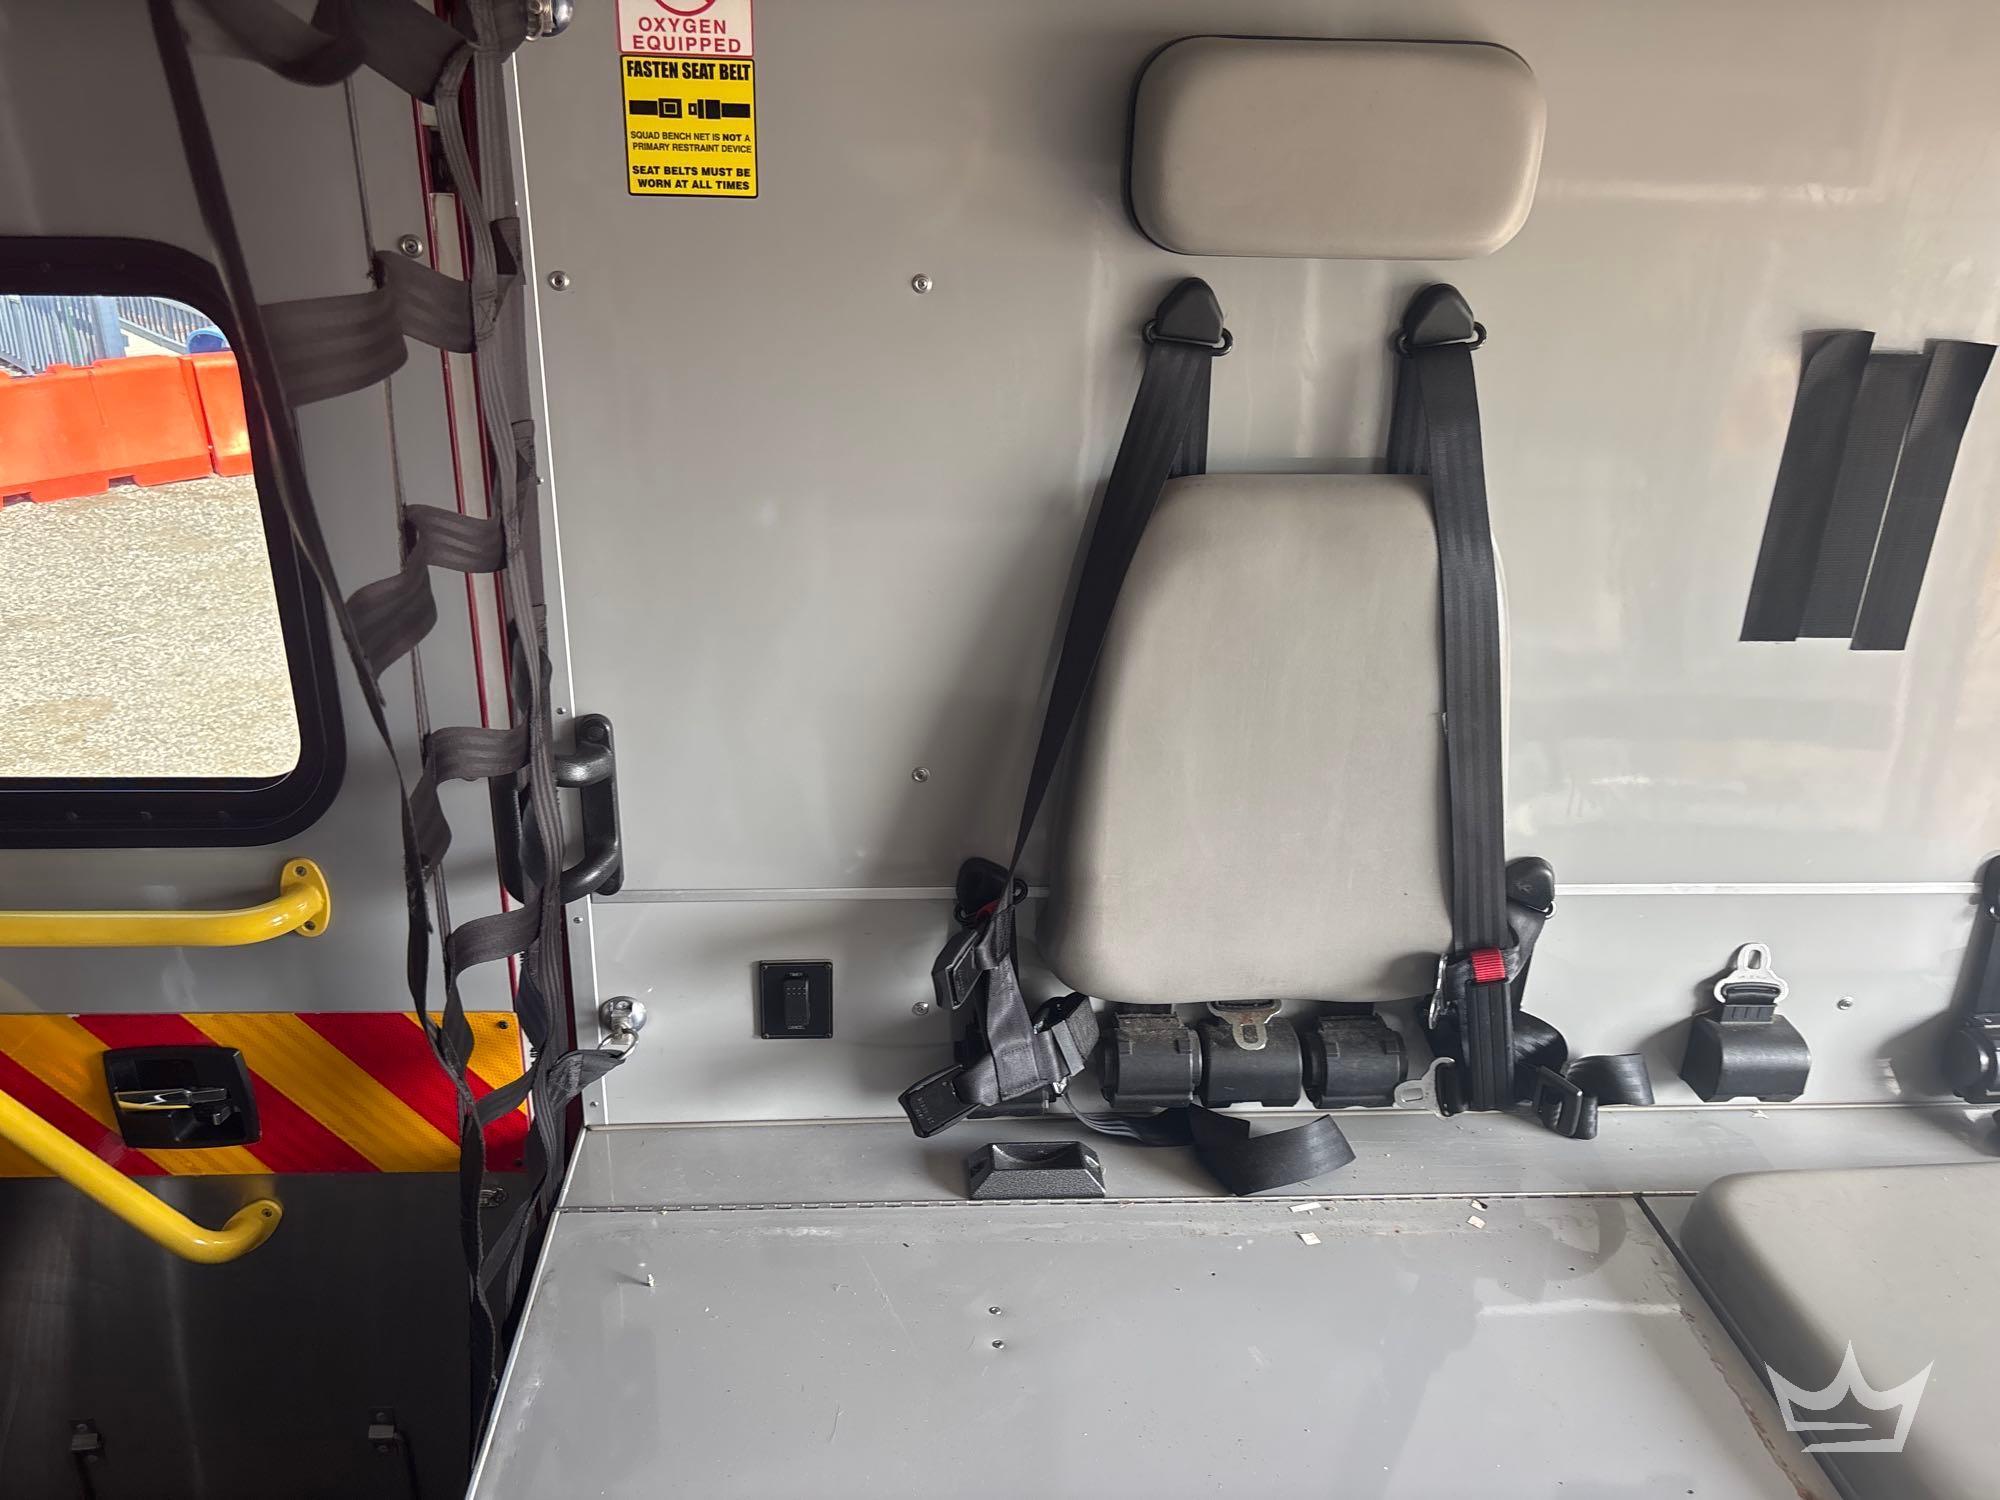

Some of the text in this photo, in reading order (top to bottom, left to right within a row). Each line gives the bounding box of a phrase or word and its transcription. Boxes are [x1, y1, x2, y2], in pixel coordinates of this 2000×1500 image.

[638, 17, 726, 34] OXYGEN
[632, 35, 740, 52] EQUIPPED
[626, 60, 750, 80] FASTEN SEAT BELT
[630, 131, 660, 140] SQUAD
[662, 132, 691, 140] BENCH
[722, 134, 742, 142] NOT
[744, 134, 750, 142] A
[632, 142, 751, 153] PRIMARY RESTRAINT DEVICE
[632, 166, 750, 176] SEAT BELTS MUST BE
[638, 179, 749, 190] WORN AT ALL TIMES
